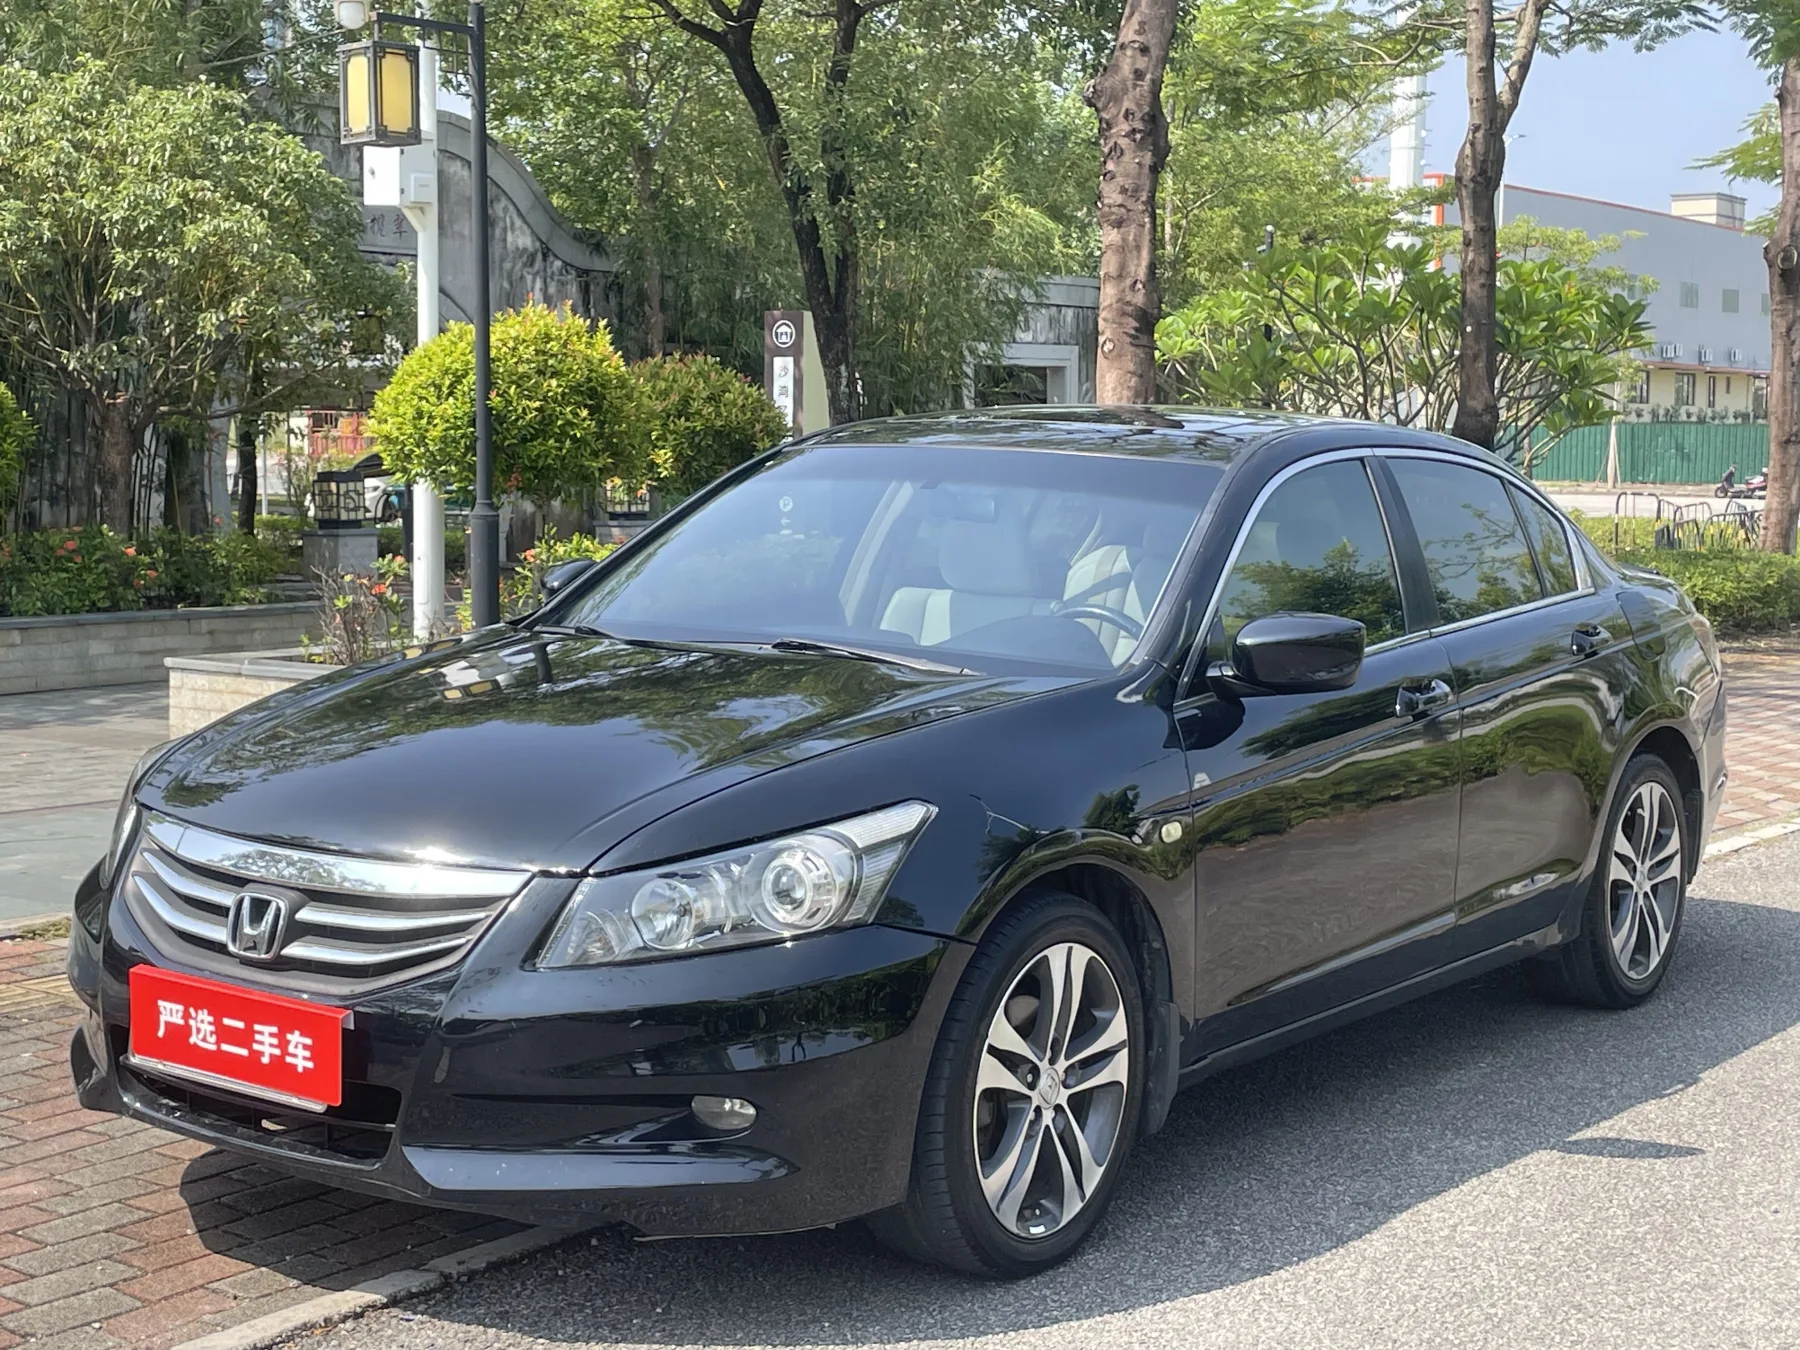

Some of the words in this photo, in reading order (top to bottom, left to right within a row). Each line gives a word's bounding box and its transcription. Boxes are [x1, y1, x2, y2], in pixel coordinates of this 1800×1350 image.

[157, 999, 315, 1073] 严选二手车
